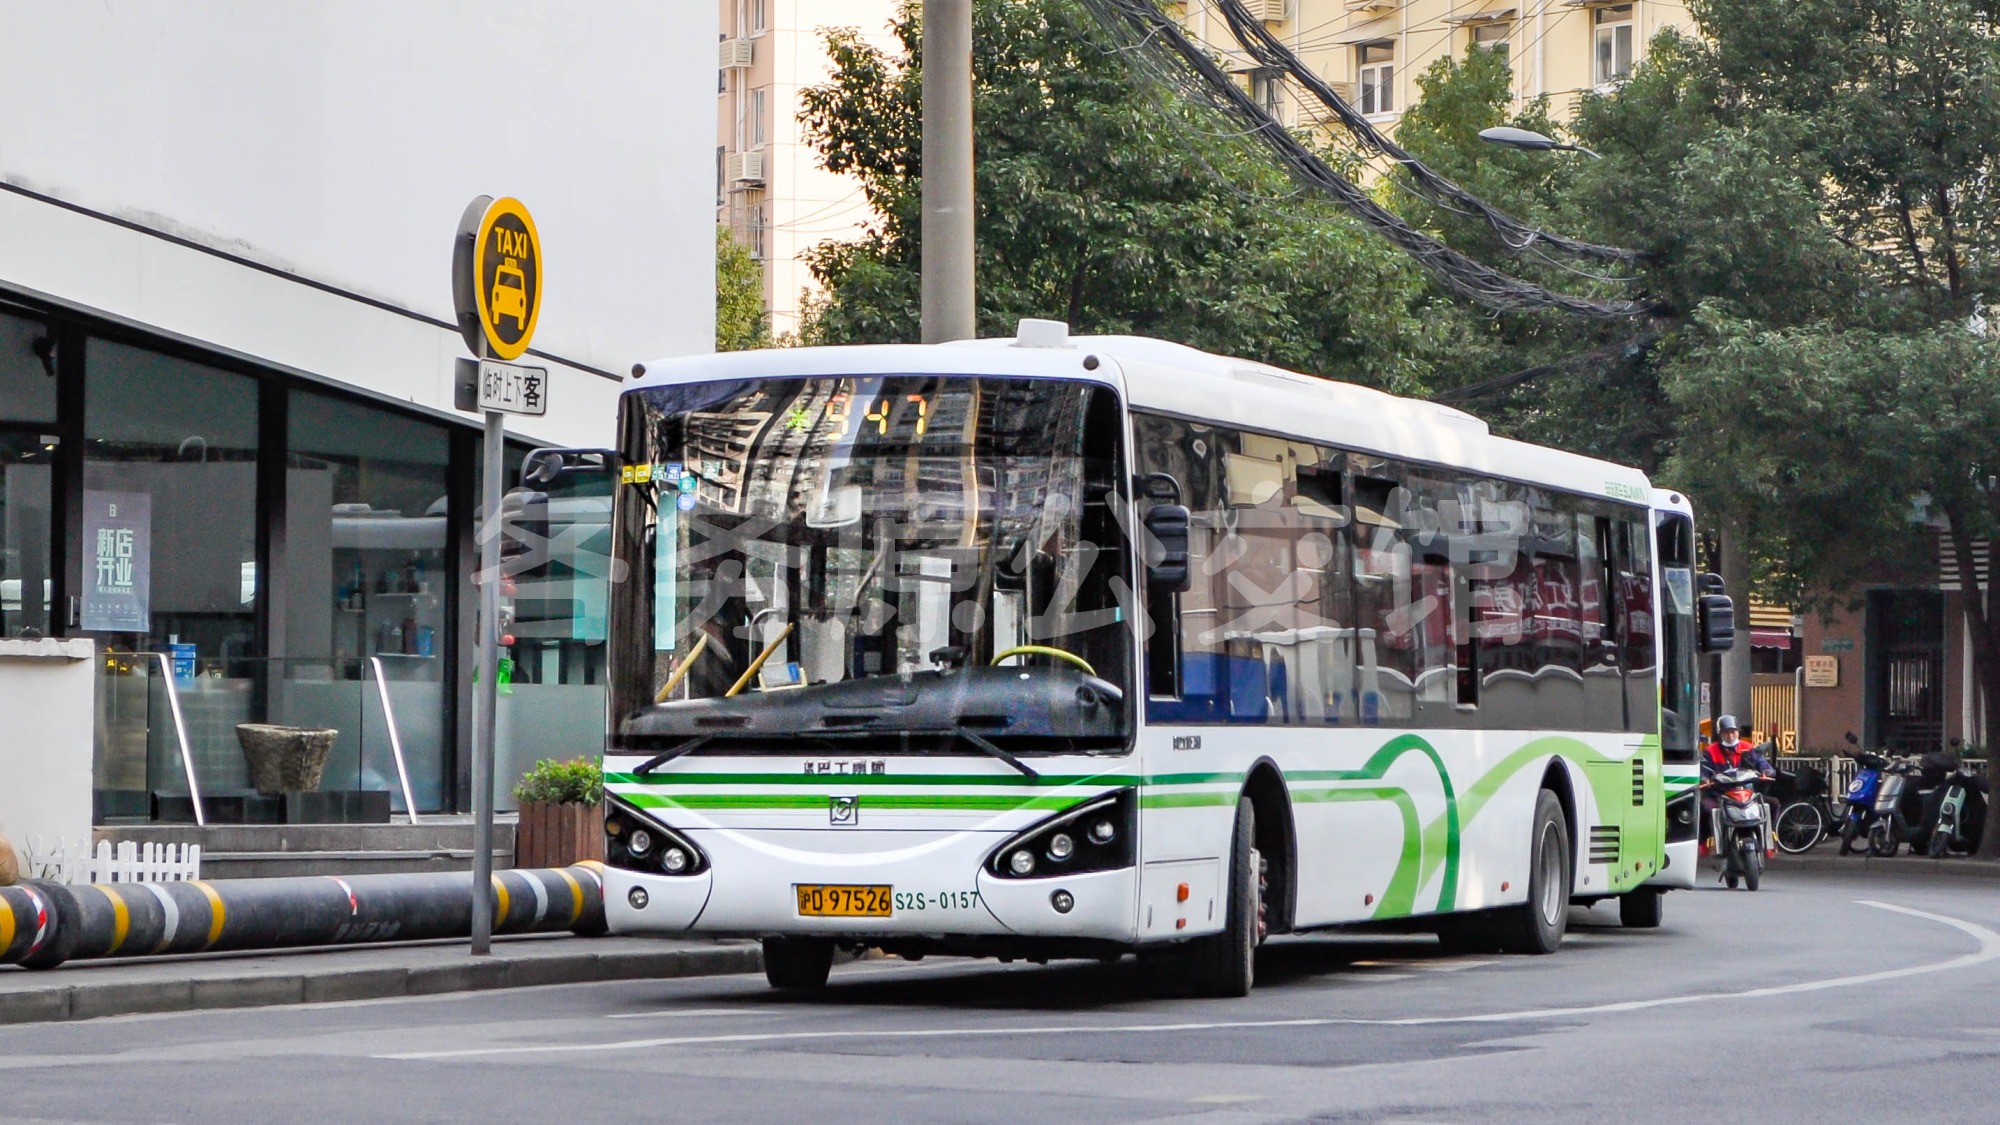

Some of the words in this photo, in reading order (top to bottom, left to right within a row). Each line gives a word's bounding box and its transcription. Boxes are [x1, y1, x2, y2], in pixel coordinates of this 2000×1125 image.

[494, 226, 528, 259] TAXI
[482, 367, 541, 408] 临时上下客
[825, 393, 927, 441] 947
[96, 528, 134, 558] 新店
[96, 557, 133, 586] 开业
[895, 891, 980, 911] S2S-0157
